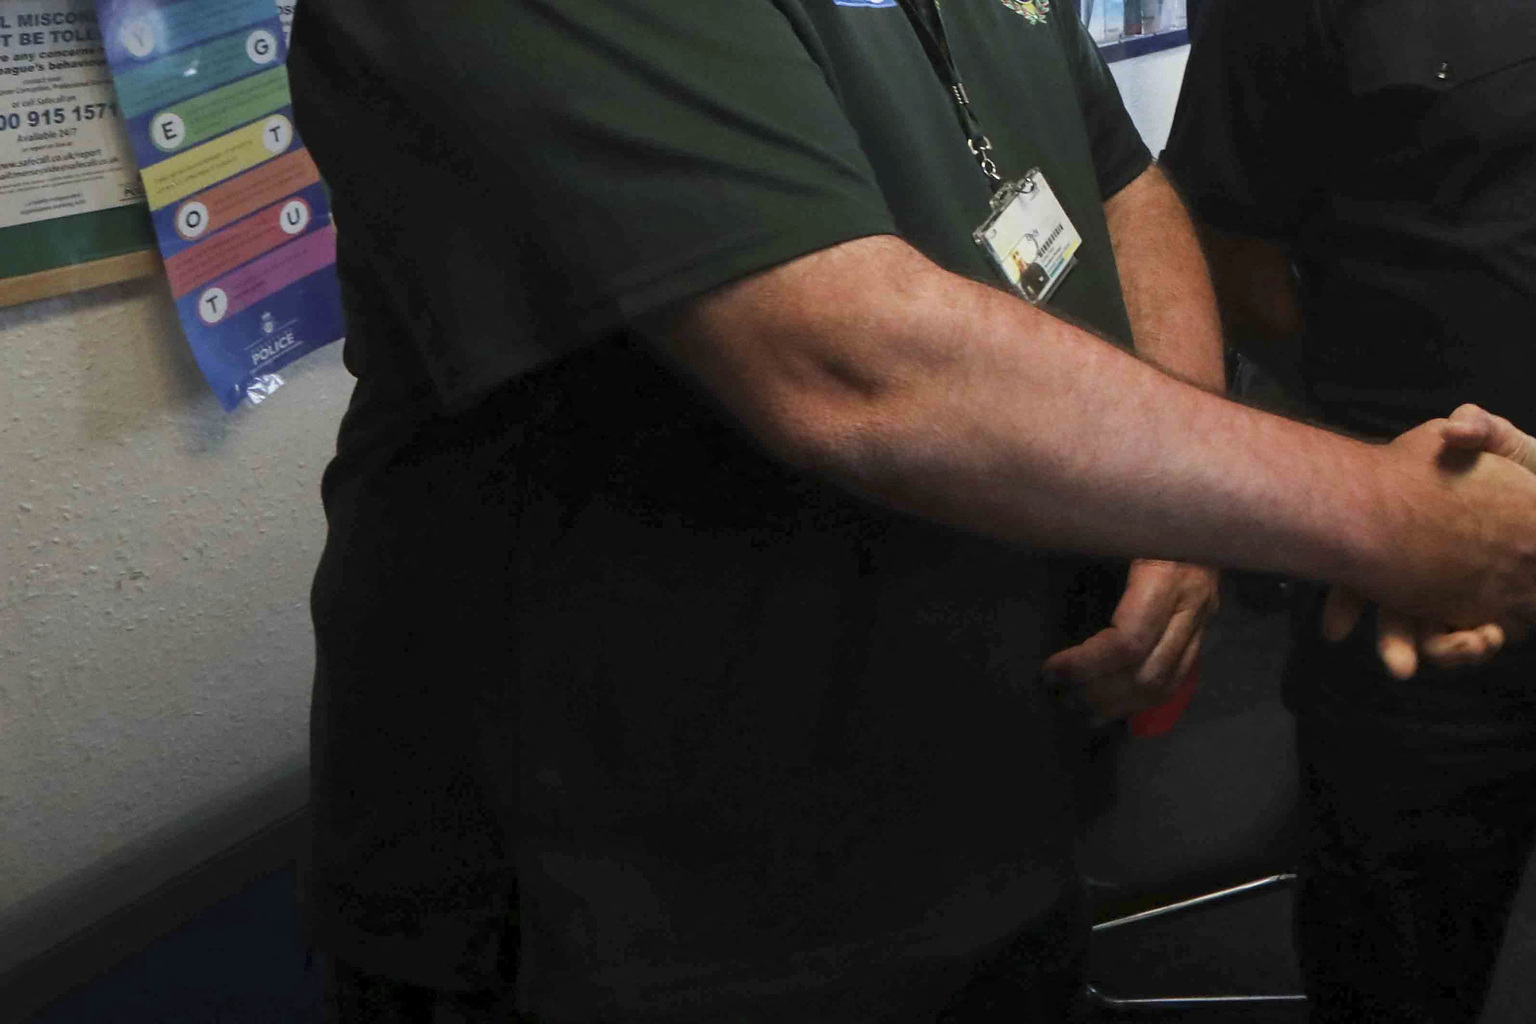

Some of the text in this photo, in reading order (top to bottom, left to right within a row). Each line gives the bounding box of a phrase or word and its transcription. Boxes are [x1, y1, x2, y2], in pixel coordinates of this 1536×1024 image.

[17, 11, 97, 28] MISCON
[19, 32, 45, 46] BE
[254, 38, 269, 55] G
[27, 108, 66, 127] 915
[161, 121, 177, 141] E
[269, 126, 282, 143] T
[185, 210, 201, 228] O
[287, 207, 301, 225] U
[206, 295, 220, 314] T
[252, 332, 296, 366] POLICE
